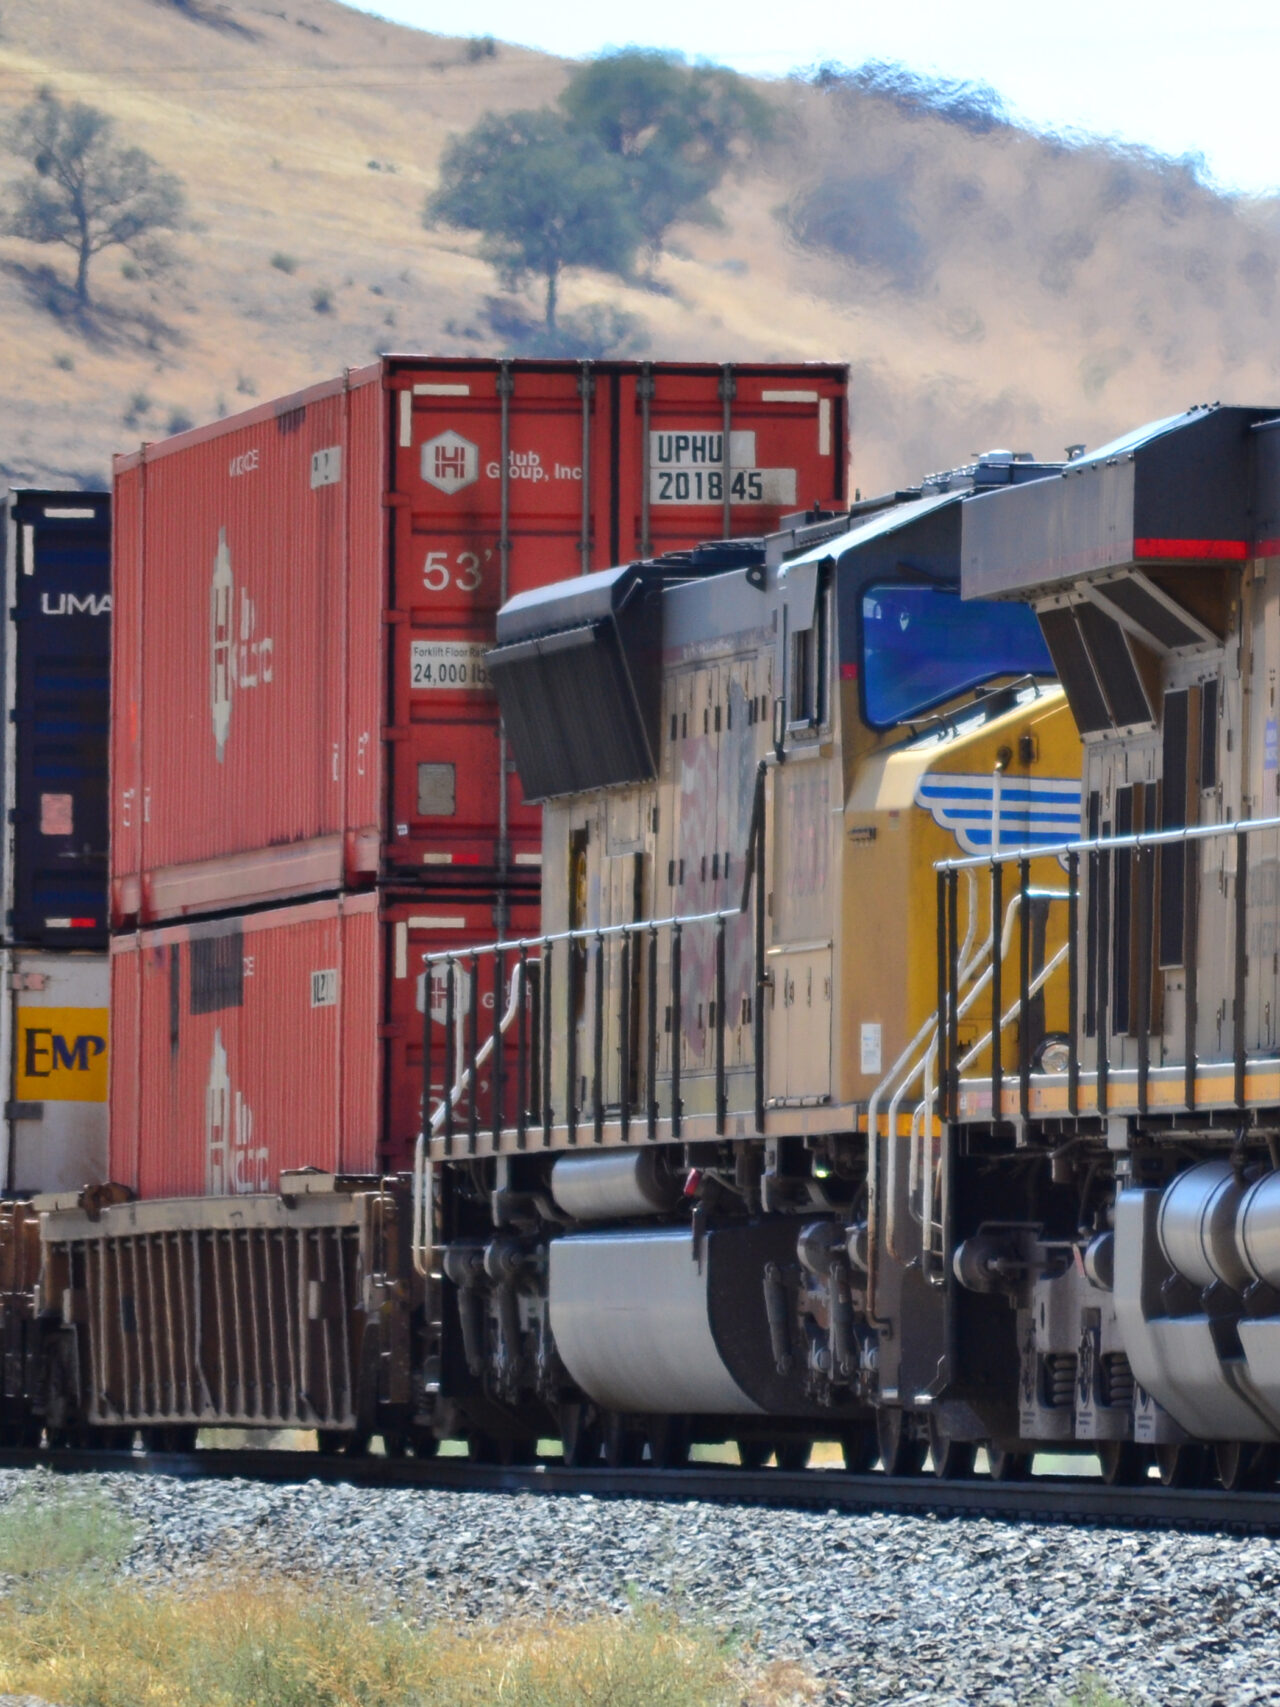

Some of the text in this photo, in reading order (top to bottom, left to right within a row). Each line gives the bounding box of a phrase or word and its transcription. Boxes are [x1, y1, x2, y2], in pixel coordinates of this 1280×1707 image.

[658, 434, 723, 463] UPHU
[486, 462, 549, 483] Goup,
[658, 472, 763, 501] 201845
[423, 549, 493, 592] 53'
[414, 663, 467, 686] 24,000
[24, 1027, 106, 1077] EMP
